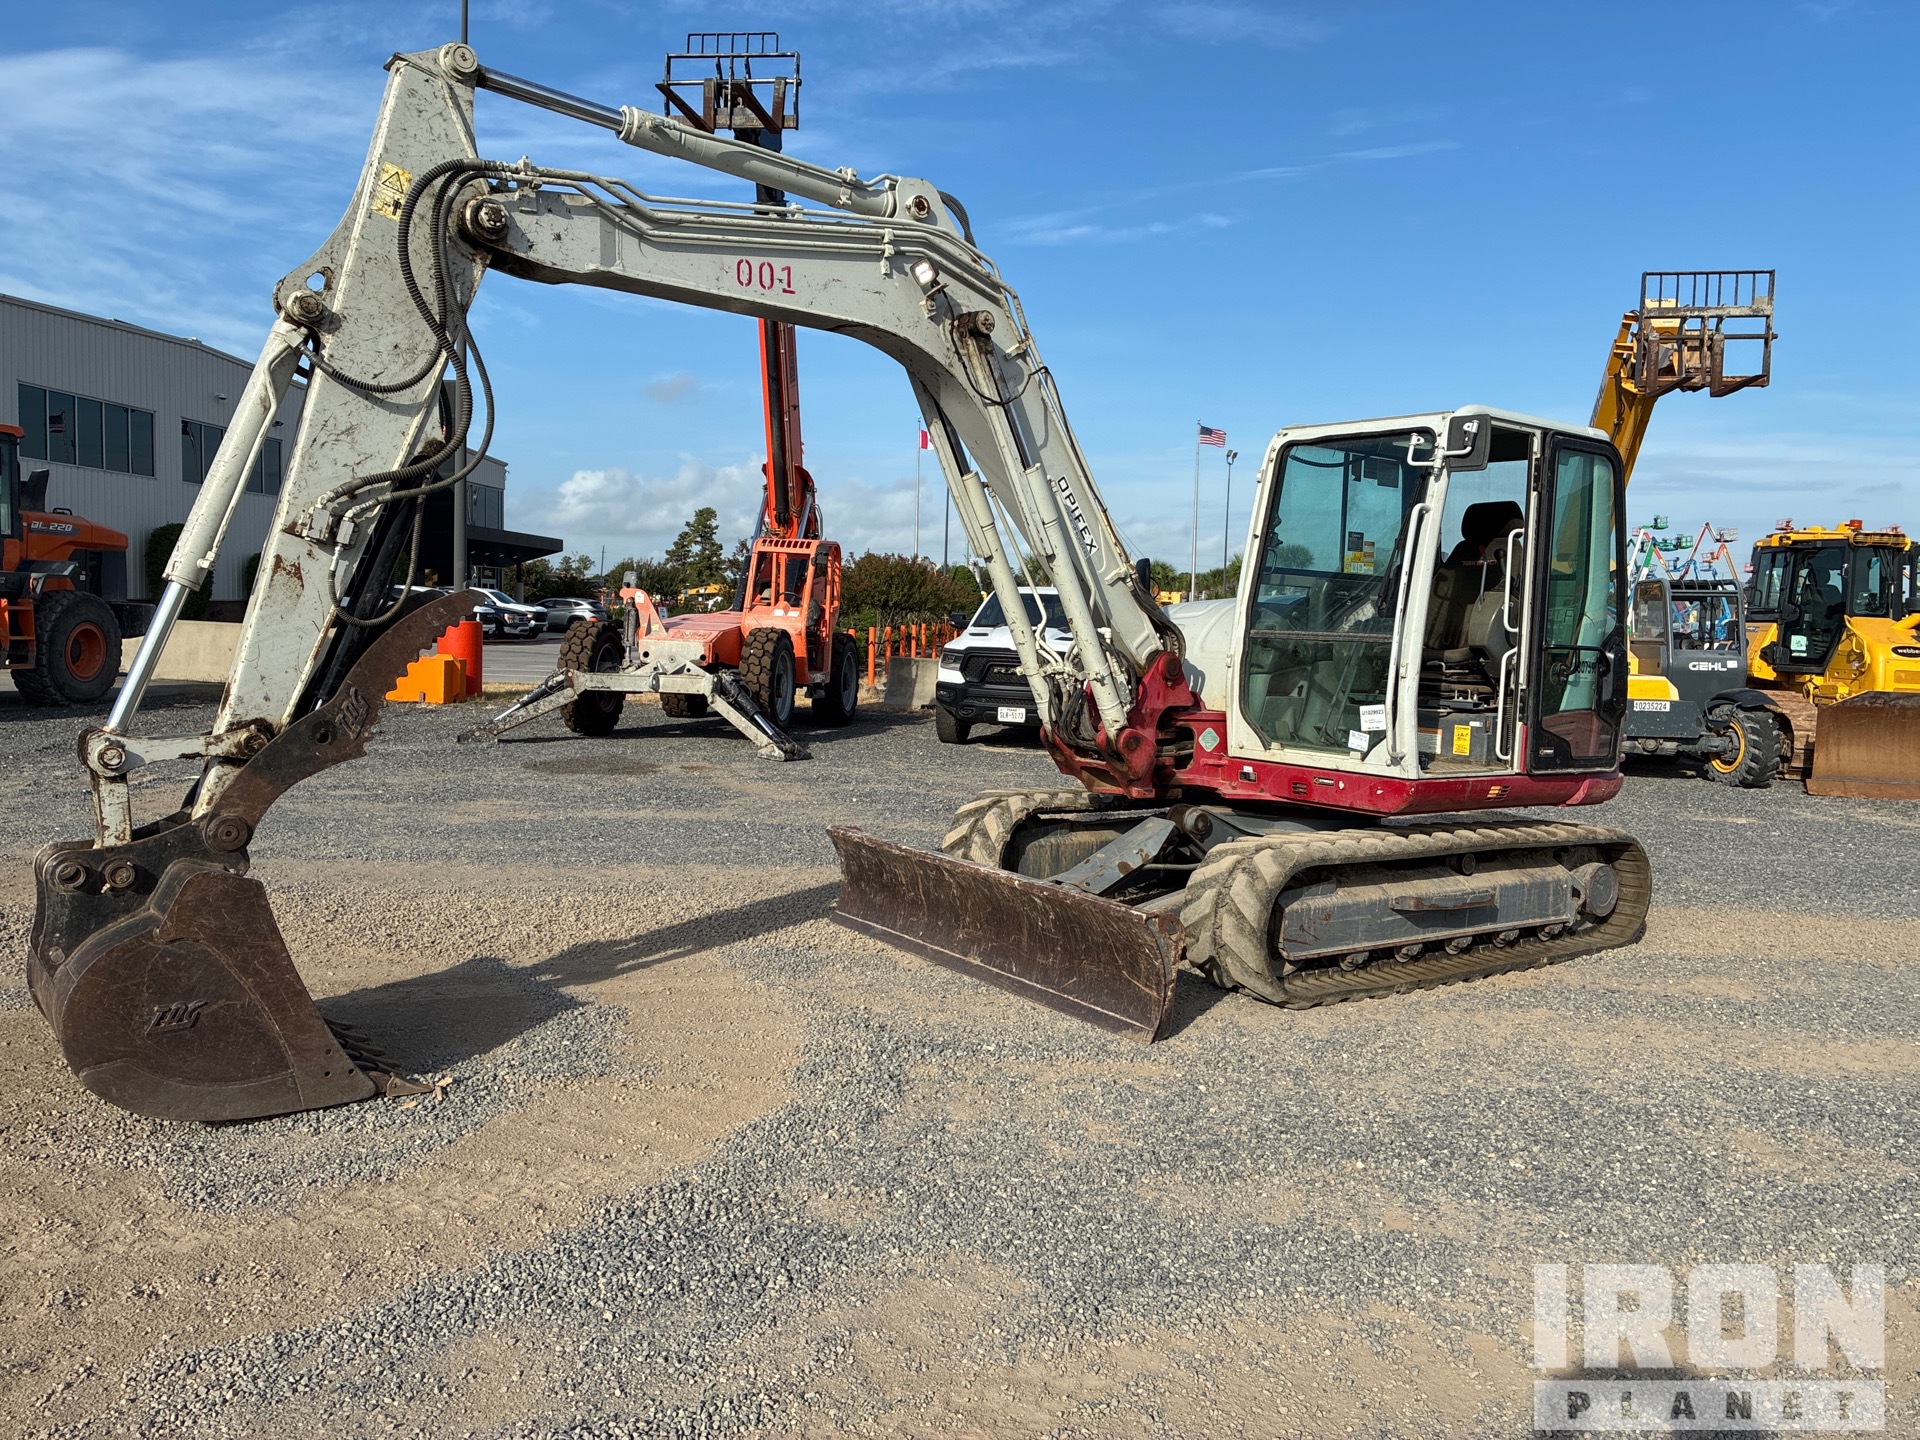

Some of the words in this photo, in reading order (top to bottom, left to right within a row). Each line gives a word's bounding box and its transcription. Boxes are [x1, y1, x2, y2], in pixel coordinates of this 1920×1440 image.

[736, 258, 796, 295] 001
[1057, 476, 1098, 555] OPIFEX
[49, 522, 73, 532] 220
[1688, 661, 1728, 671] GEHL
[1634, 701, 1667, 711] 10235224
